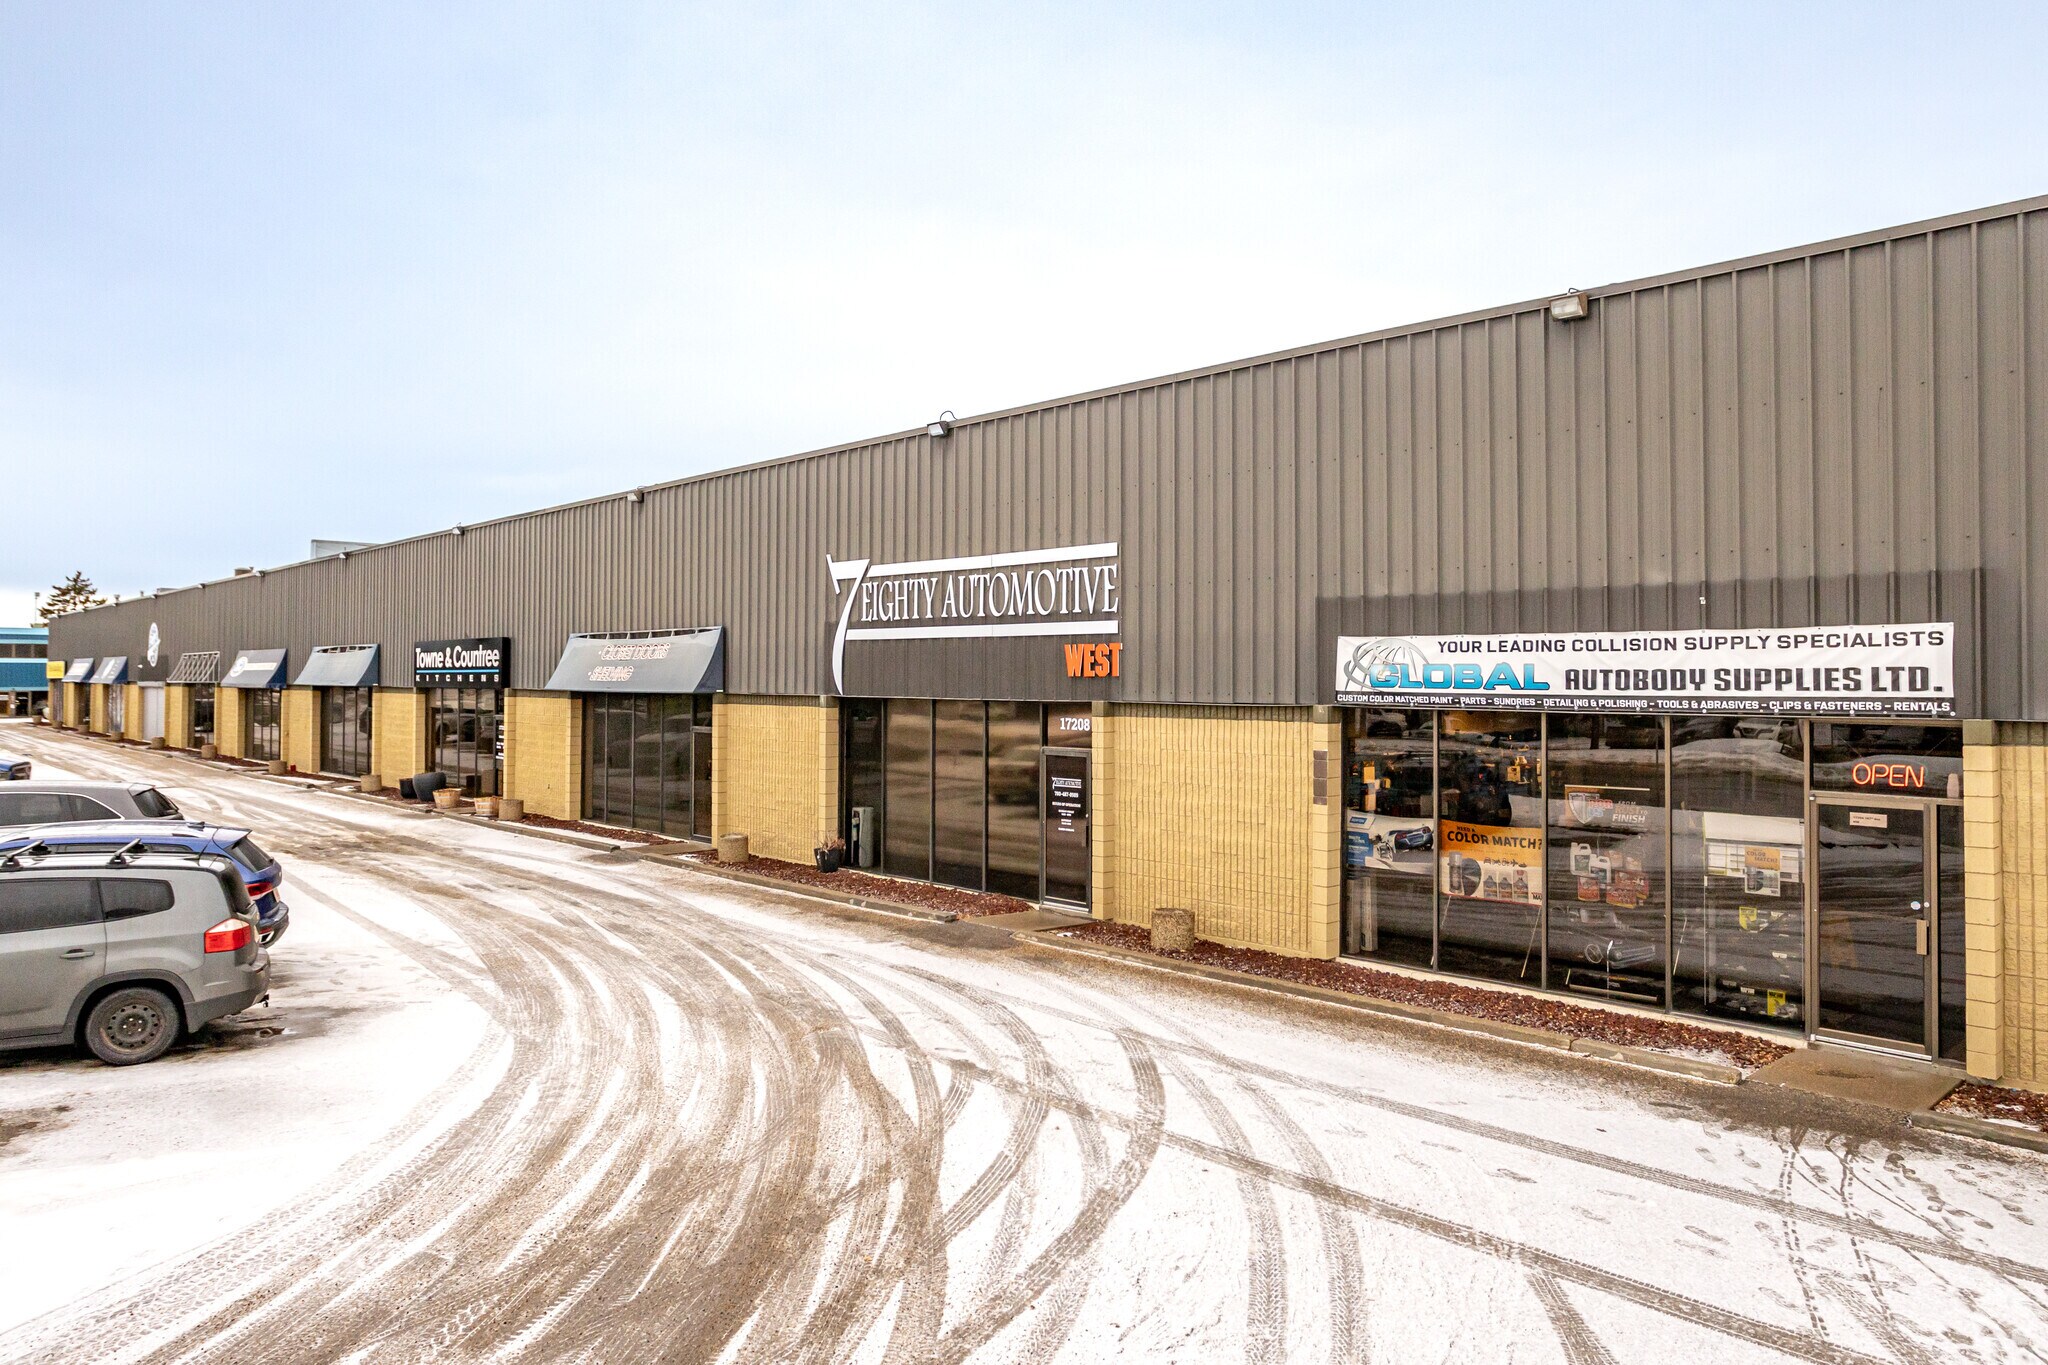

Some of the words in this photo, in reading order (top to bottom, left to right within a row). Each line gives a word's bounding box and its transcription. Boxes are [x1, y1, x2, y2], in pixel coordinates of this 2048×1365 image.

[860, 577, 938, 622] EIGHTY
[941, 563, 1119, 618] AUTOMOTIVE
[1438, 640, 1482, 653] YOUR
[1487, 639, 1566, 653] LEADING
[1572, 638, 1677, 652] COLLISION
[1684, 635, 1771, 651] SUPPLY
[1777, 631, 1944, 649] SPECIALISTS
[415, 648, 444, 668] Towne
[445, 647, 452, 668] &
[453, 644, 500, 668] Countree
[1064, 642, 1123, 678] WEST
[415, 674, 499, 682] KITCHENS
[1369, 662, 1550, 690] GLOBAL
[1565, 668, 1706, 691] AUTOBODY
[1714, 667, 1862, 692] SUPPLIES
[1871, 666, 1943, 692] LTD.
[1337, 694, 1368, 703] CUSTOM
[1370, 695, 1394, 703] COLOR
[1395, 695, 1430, 704] MATCHED
[1430, 696, 1452, 705] PAINT
[1461, 696, 1486, 705] PARTS
[1494, 697, 1536, 706] SUNDRIES
[1543, 698, 1589, 707] DETAILING
[1590, 699, 1597, 707] &
[1599, 699, 1647, 708] POLISHING
[1658, 700, 1689, 709] TOOLS
[1691, 701, 1698, 709] &
[1700, 701, 1759, 710] ABRASIVES
[1769, 701, 1802, 710] CLIPS
[1804, 702, 1812, 710] &
[1814, 702, 1882, 711] FASTENERS
[1894, 702, 1950, 712] RENTALS
[1060, 717, 1090, 731] 17208
[1853, 763, 1924, 788] OPEN
[1612, 814, 1646, 823] FINISH
[1447, 831, 1489, 845] COLOR
